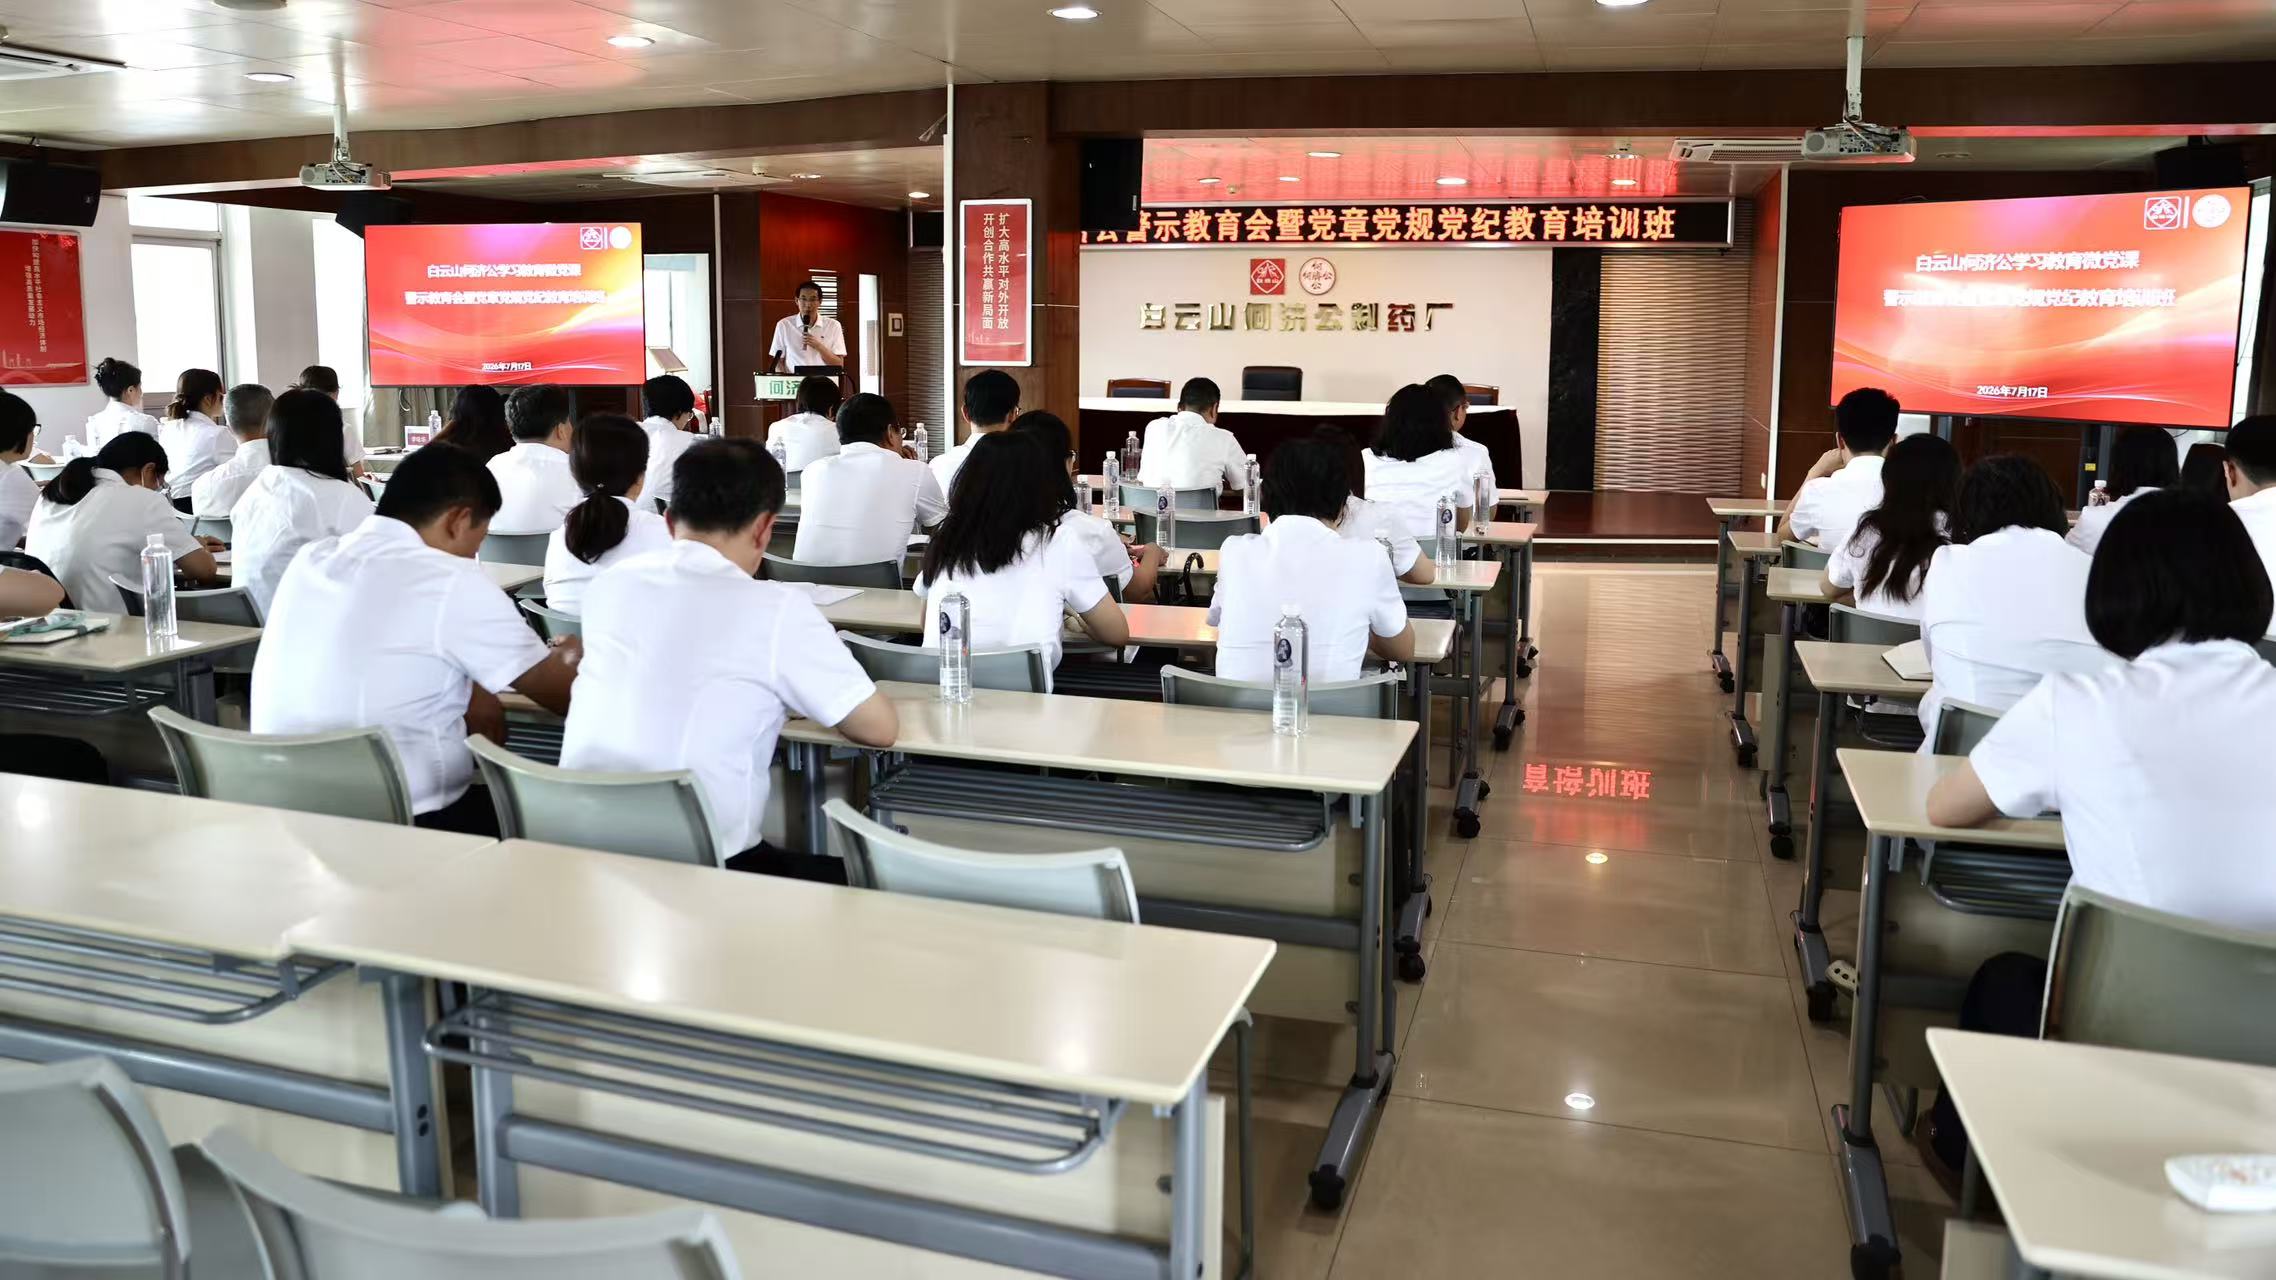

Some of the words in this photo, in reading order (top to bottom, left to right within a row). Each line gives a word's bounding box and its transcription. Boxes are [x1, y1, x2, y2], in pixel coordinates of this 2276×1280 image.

[1080, 205, 1676, 243] 警示教育会暨党章党规党纪教育培训班
[982, 213, 995, 329] 开创合作共赢新局面
[997, 213, 1010, 329] 扩大高水平对外开放
[1915, 250, 2140, 272] 白云山何济公学习教育微党课
[1139, 302, 1455, 332] 白云山何济公制药厂
[1976, 384, 2048, 399] 2026年7月17日
